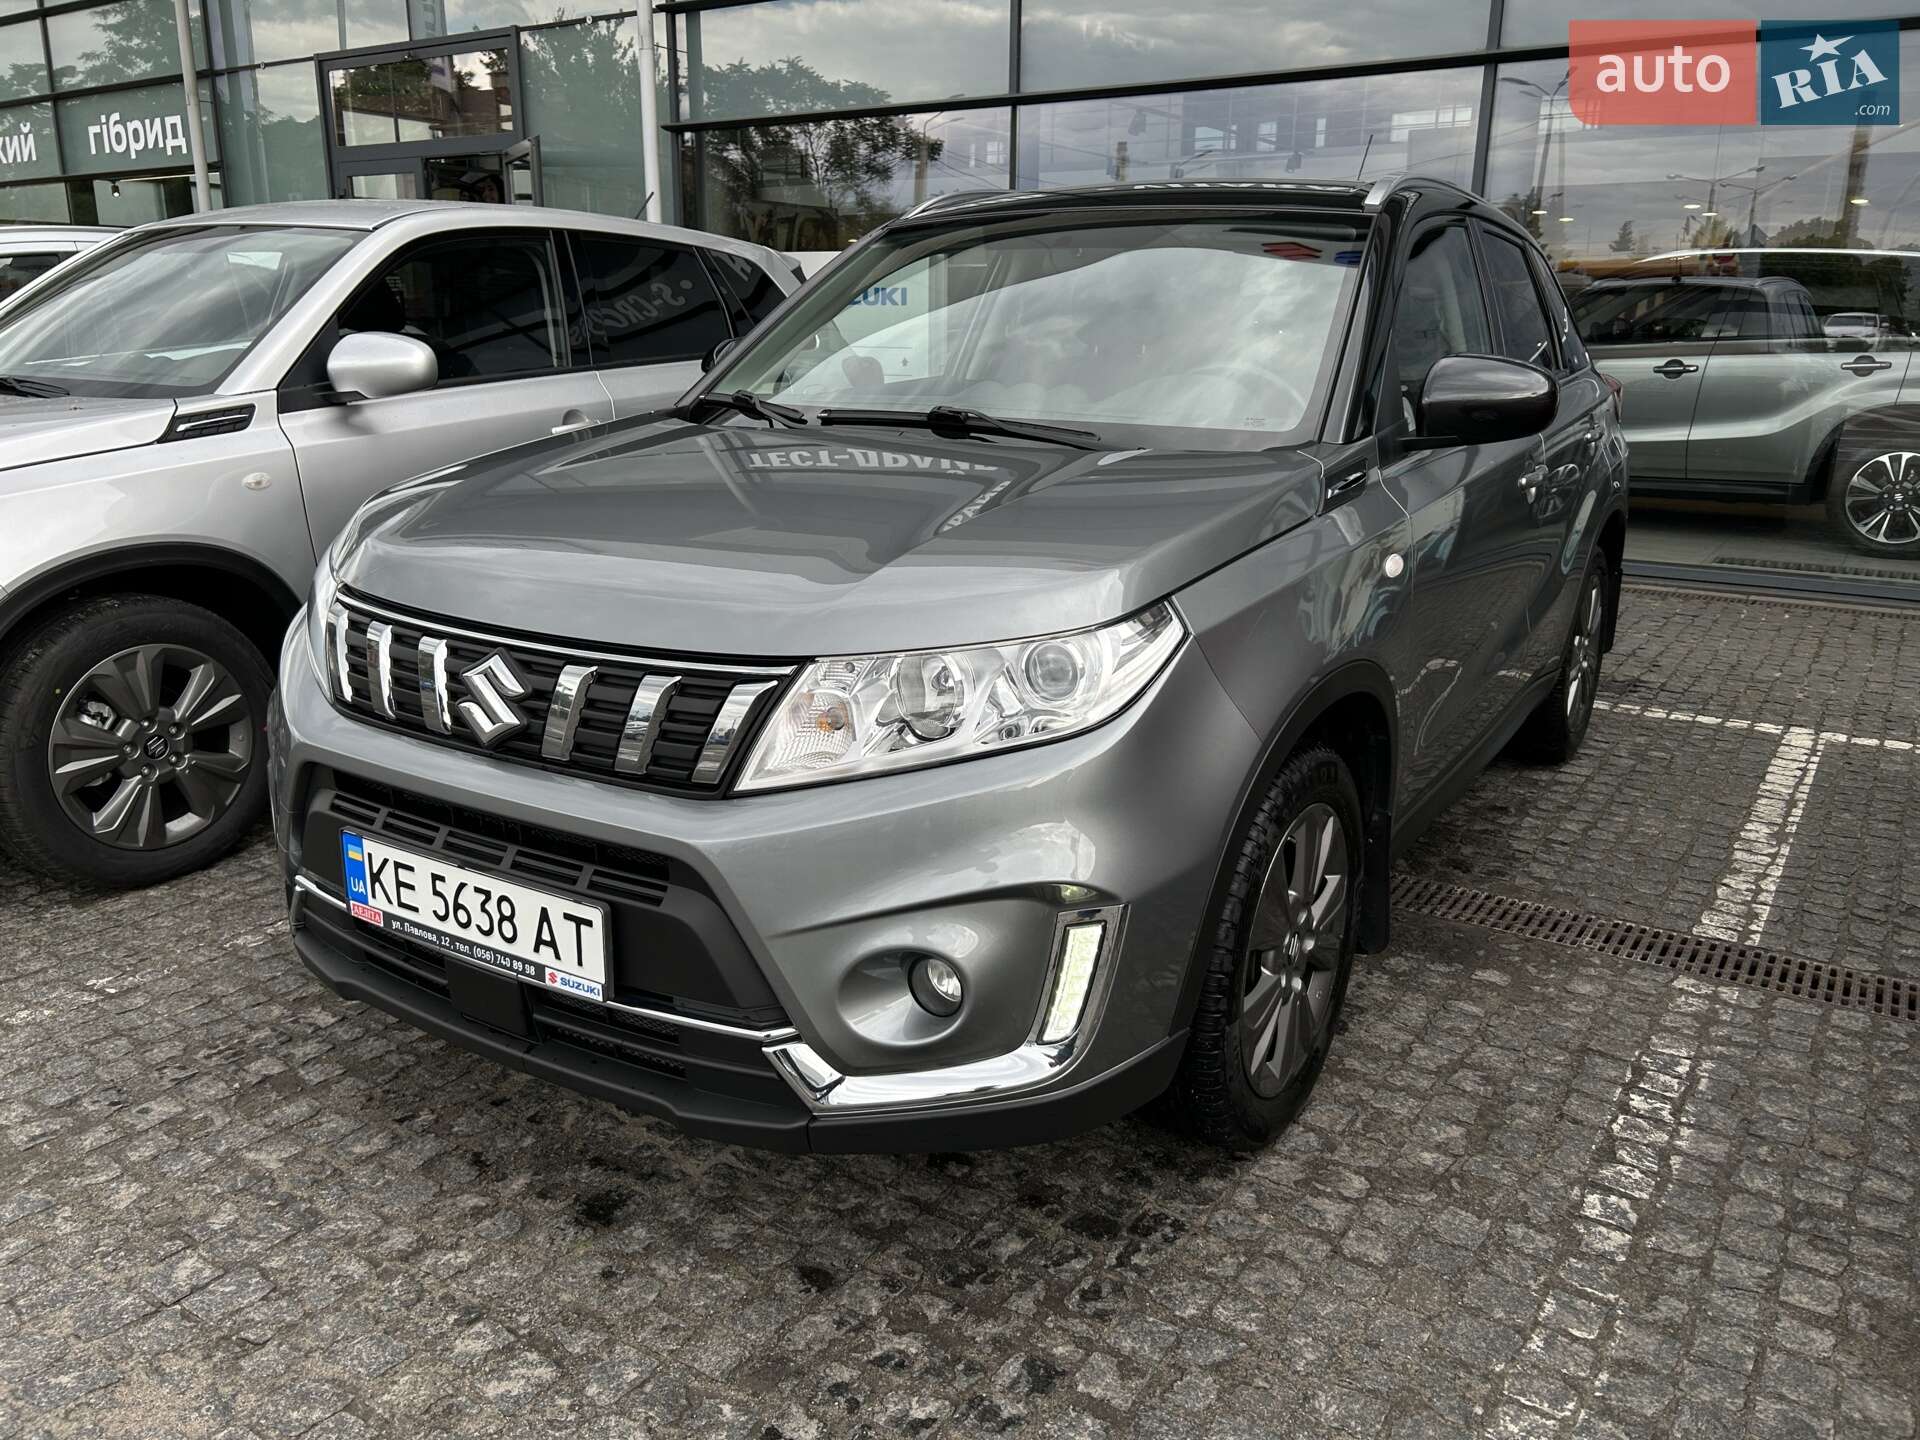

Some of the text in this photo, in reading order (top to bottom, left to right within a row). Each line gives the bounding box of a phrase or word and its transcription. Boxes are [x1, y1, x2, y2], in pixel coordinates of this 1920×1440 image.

[88, 112, 188, 159] гібрид
[351, 876, 367, 895] UA
[367, 852, 594, 967] KE 5638 AT
[391, 919, 404, 932] ул.
[404, 922, 439, 945] Павлова,
[455, 942, 472, 956] тел.
[560, 976, 601, 998] SUZUKI
